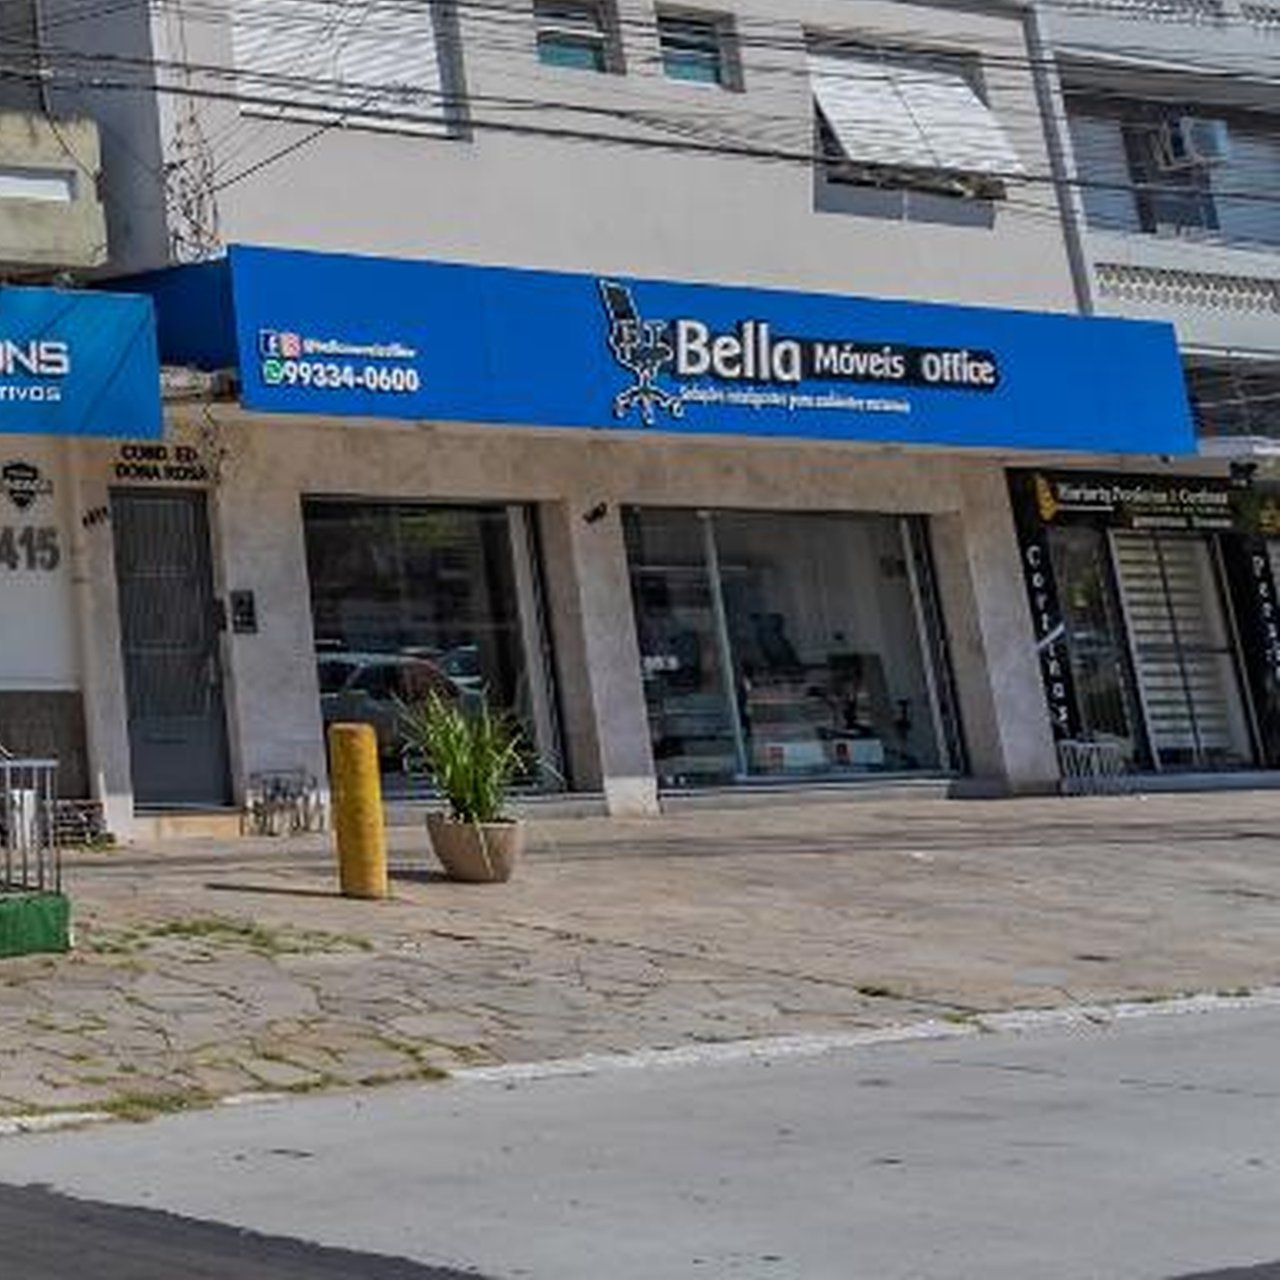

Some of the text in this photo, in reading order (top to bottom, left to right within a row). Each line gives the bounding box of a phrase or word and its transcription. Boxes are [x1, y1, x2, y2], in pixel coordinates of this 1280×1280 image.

[283, 360, 419, 391] 99334-0600
[675, 320, 995, 385] Bella Móveis Office
